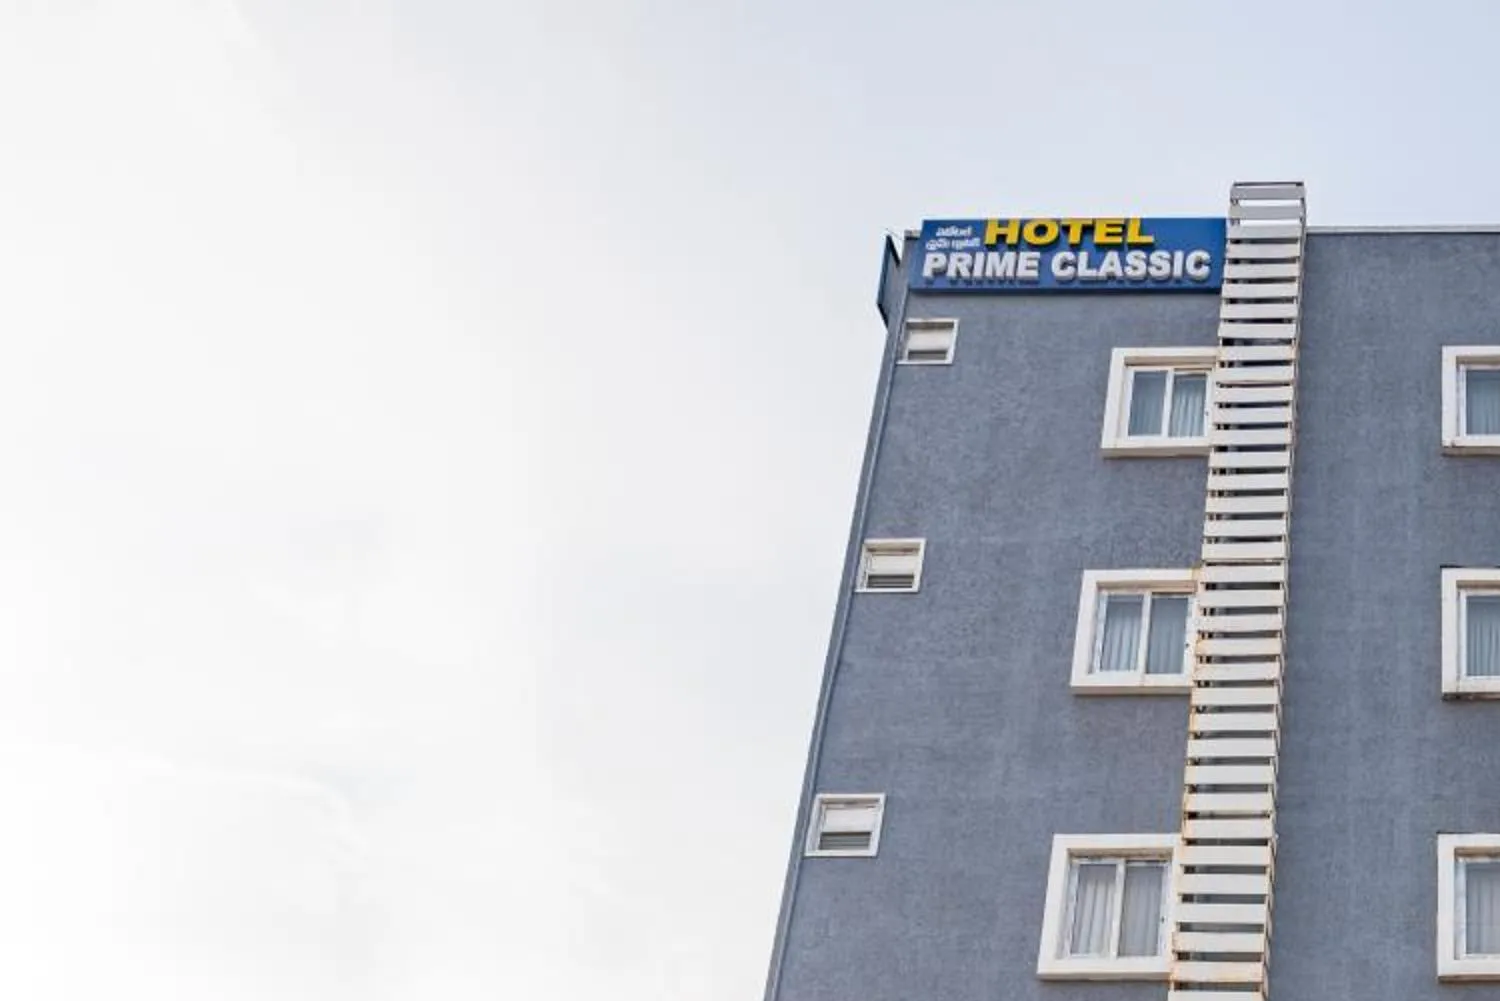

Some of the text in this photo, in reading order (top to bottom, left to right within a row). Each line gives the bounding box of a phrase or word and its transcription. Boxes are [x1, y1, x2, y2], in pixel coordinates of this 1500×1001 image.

[984, 217, 1155, 246] HOTEL
[922, 250, 1211, 281] PRIME CLASSIC
